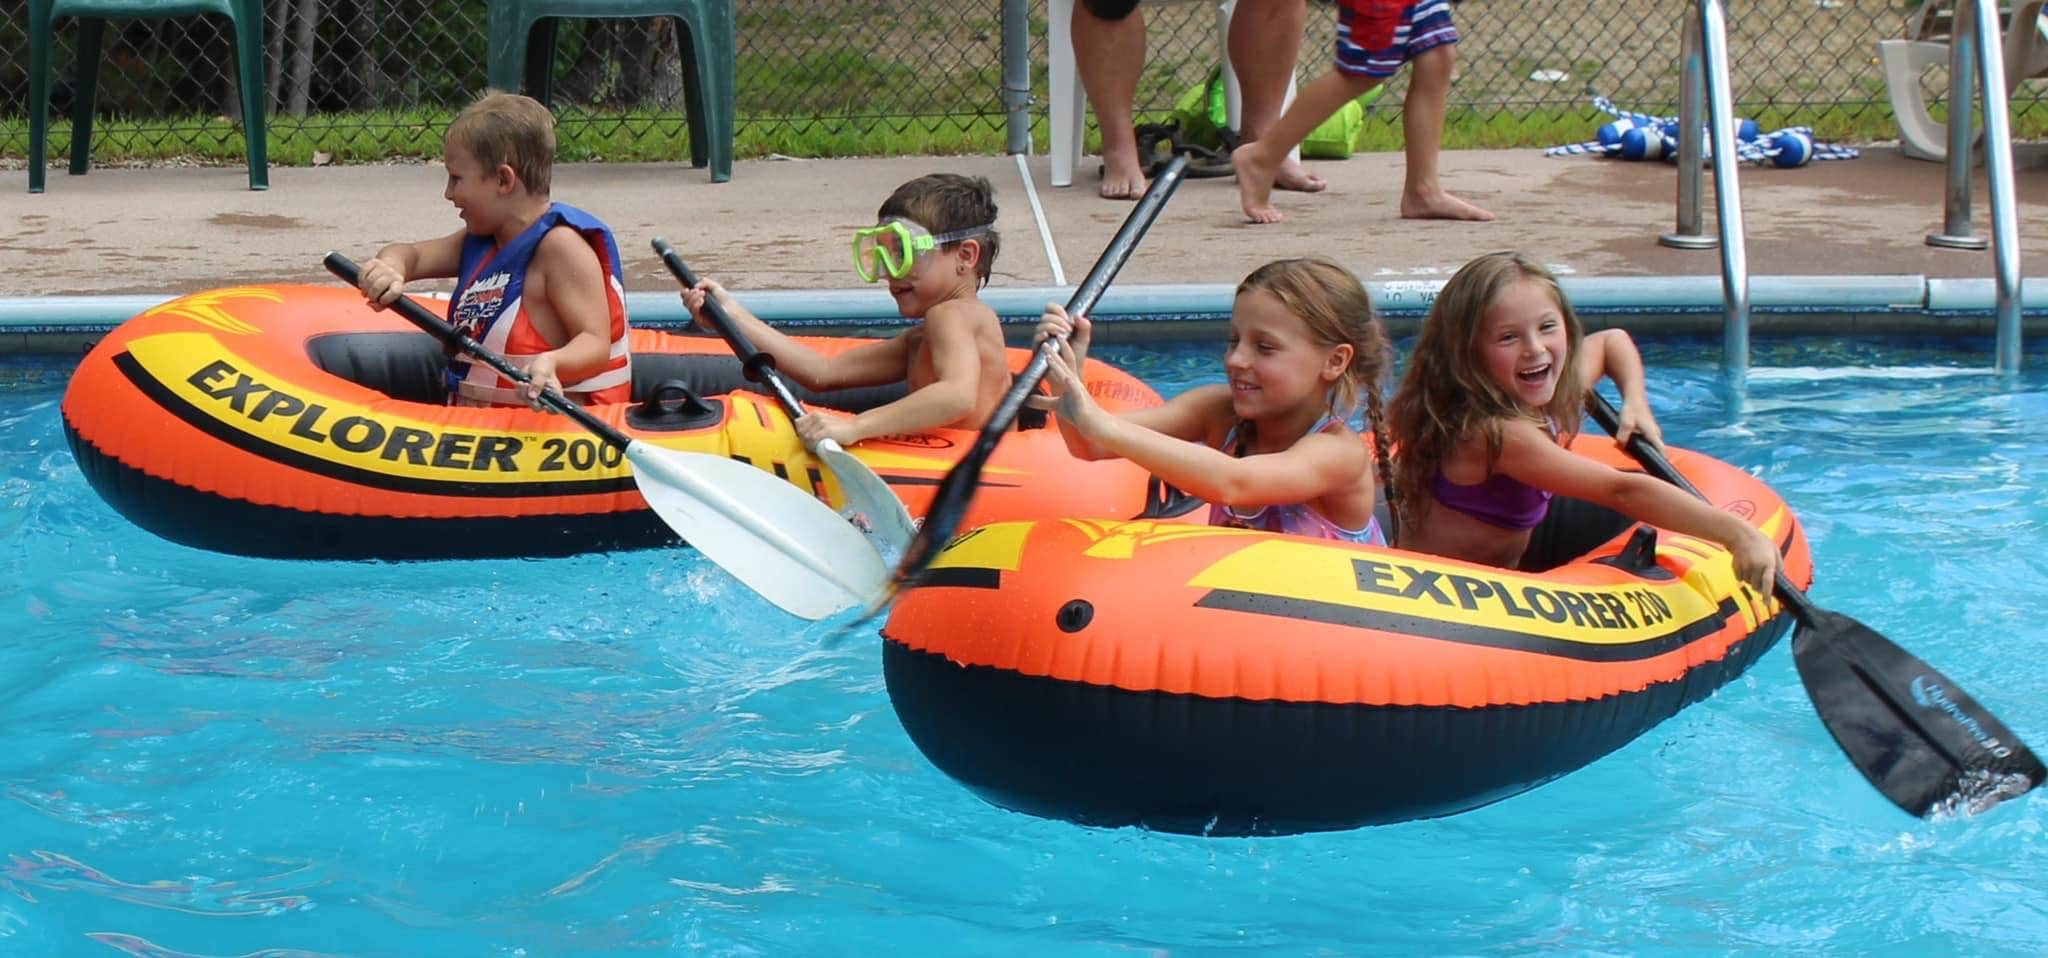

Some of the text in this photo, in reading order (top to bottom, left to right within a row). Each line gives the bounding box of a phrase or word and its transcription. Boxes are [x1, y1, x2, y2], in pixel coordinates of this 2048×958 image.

[187, 360, 524, 472] EXPLORER
[538, 438, 623, 471] 200
[1351, 558, 1673, 629] EXPLORER 200
